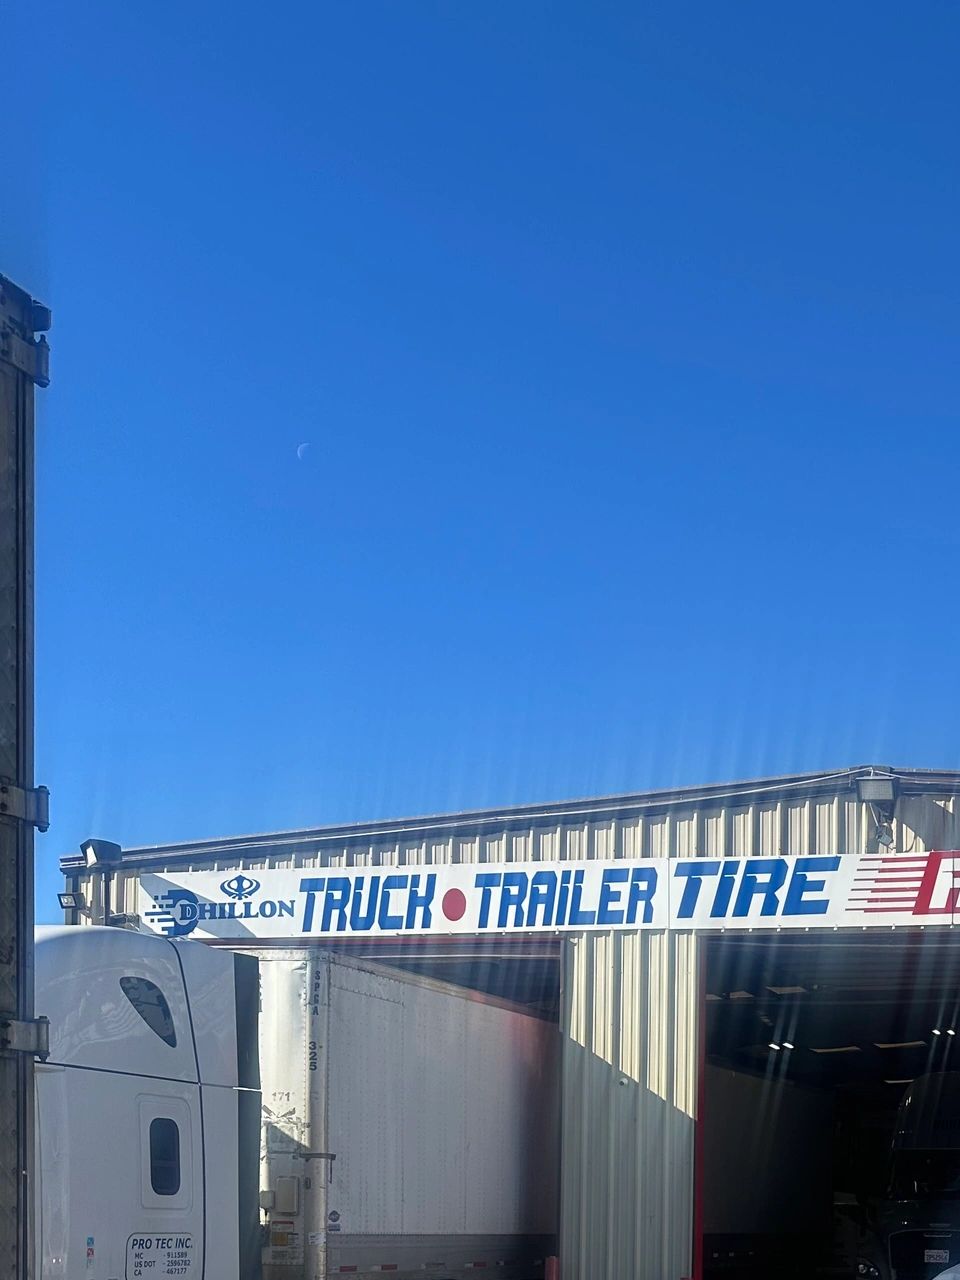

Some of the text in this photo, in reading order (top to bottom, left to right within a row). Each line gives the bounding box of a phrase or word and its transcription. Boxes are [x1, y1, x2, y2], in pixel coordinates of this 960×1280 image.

[299, 874, 437, 933] TRUCK
[474, 866, 659, 929] TRAILER
[674, 855, 842, 919] TIRE
[180, 900, 296, 922] DHILLON
[308, 1041, 318, 1071] 325
[132, 1238, 193, 1249] PRO TEC INC.
